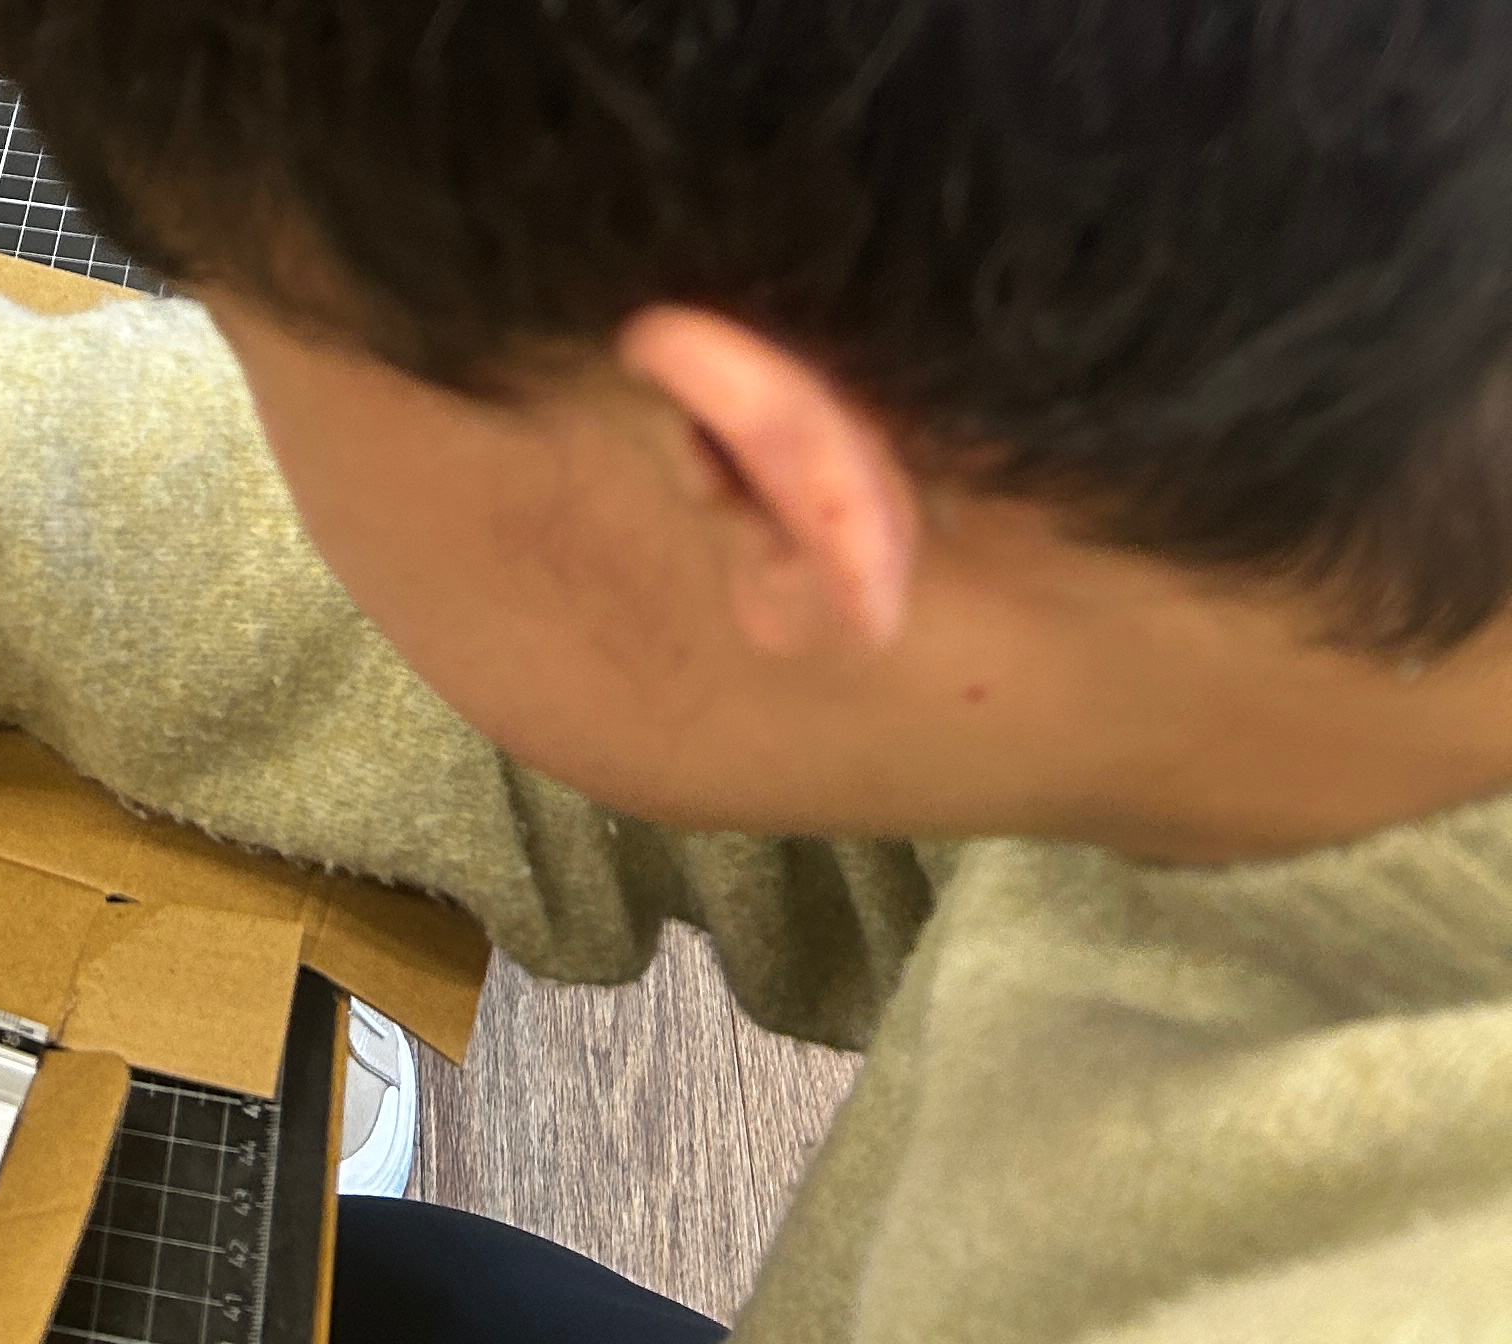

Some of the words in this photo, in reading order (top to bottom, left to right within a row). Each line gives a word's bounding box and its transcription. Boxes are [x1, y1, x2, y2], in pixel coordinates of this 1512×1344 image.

[232, 1188, 252, 1217] 43
[226, 1238, 249, 1269] 42
[222, 1293, 243, 1322] 41
